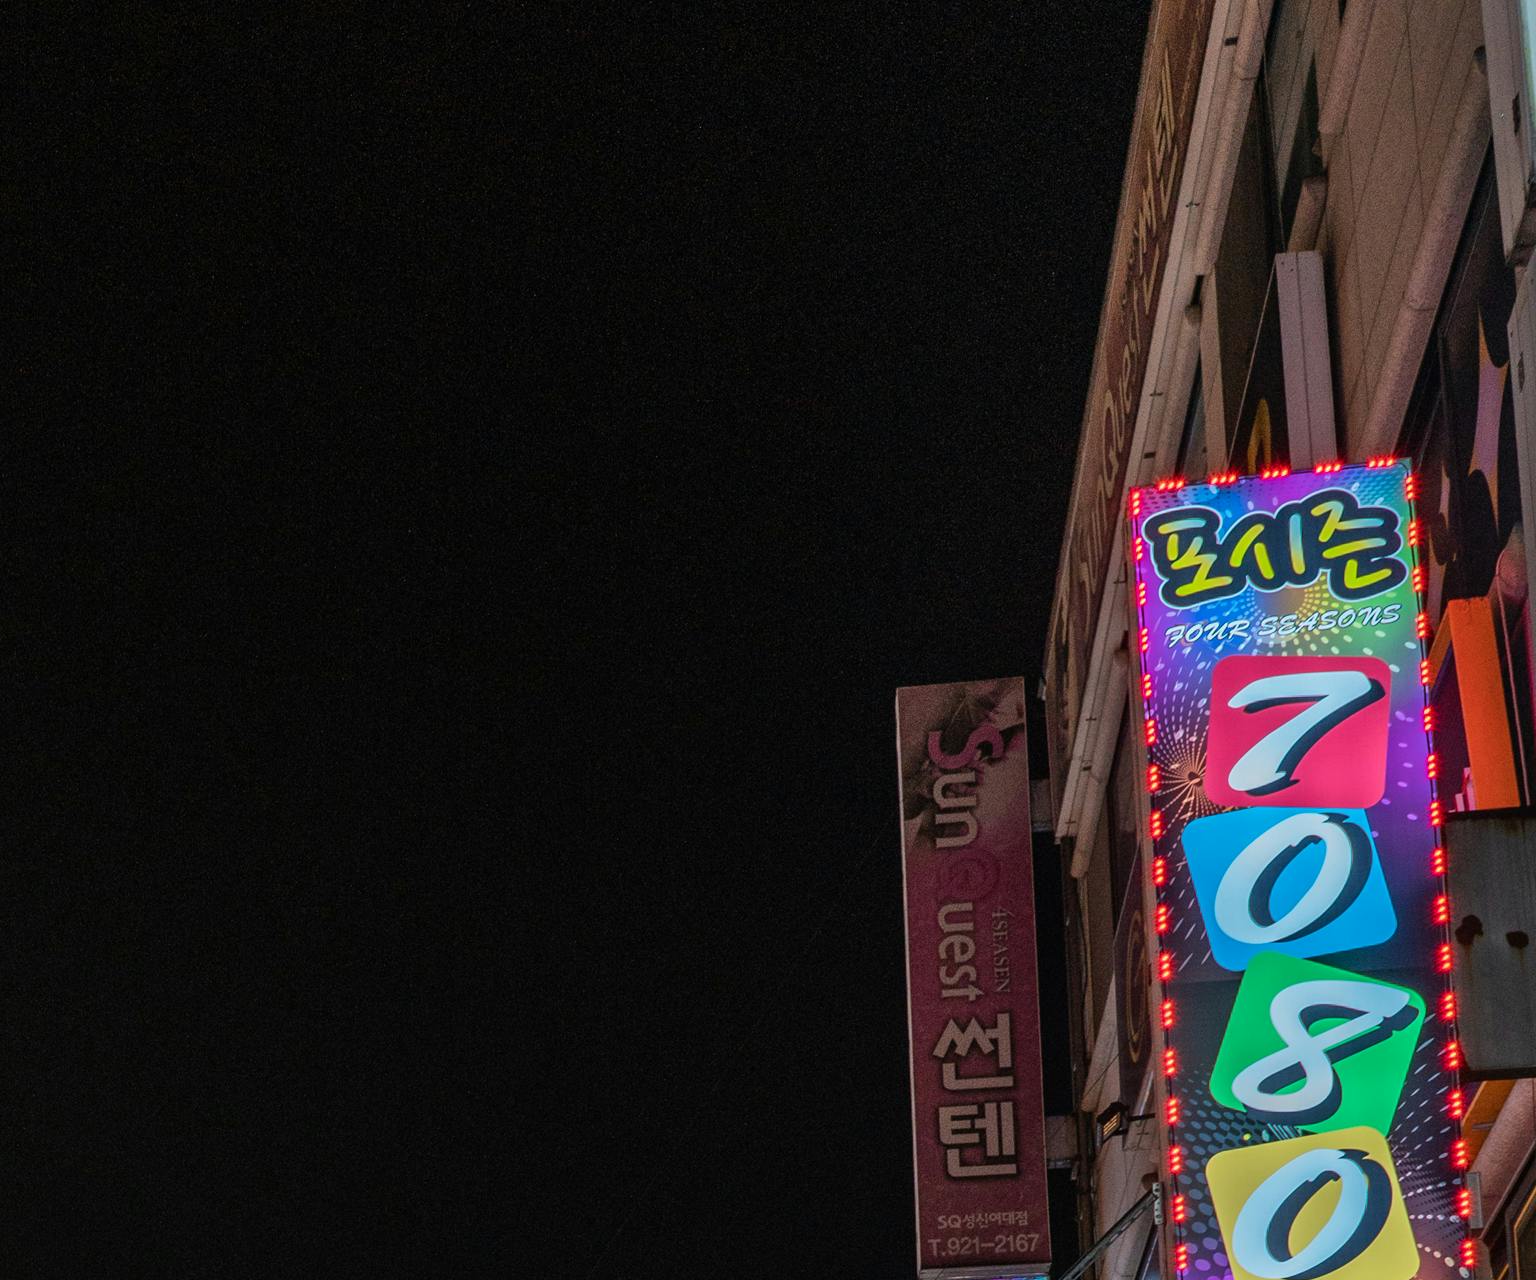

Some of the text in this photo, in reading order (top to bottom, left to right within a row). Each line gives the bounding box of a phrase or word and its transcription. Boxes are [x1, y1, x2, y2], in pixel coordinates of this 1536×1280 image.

[1154, 496, 1396, 600] 포시즌
[1164, 604, 1401, 649] FOUR SEASONS
[927, 1234, 1041, 1259] T.921-2167
